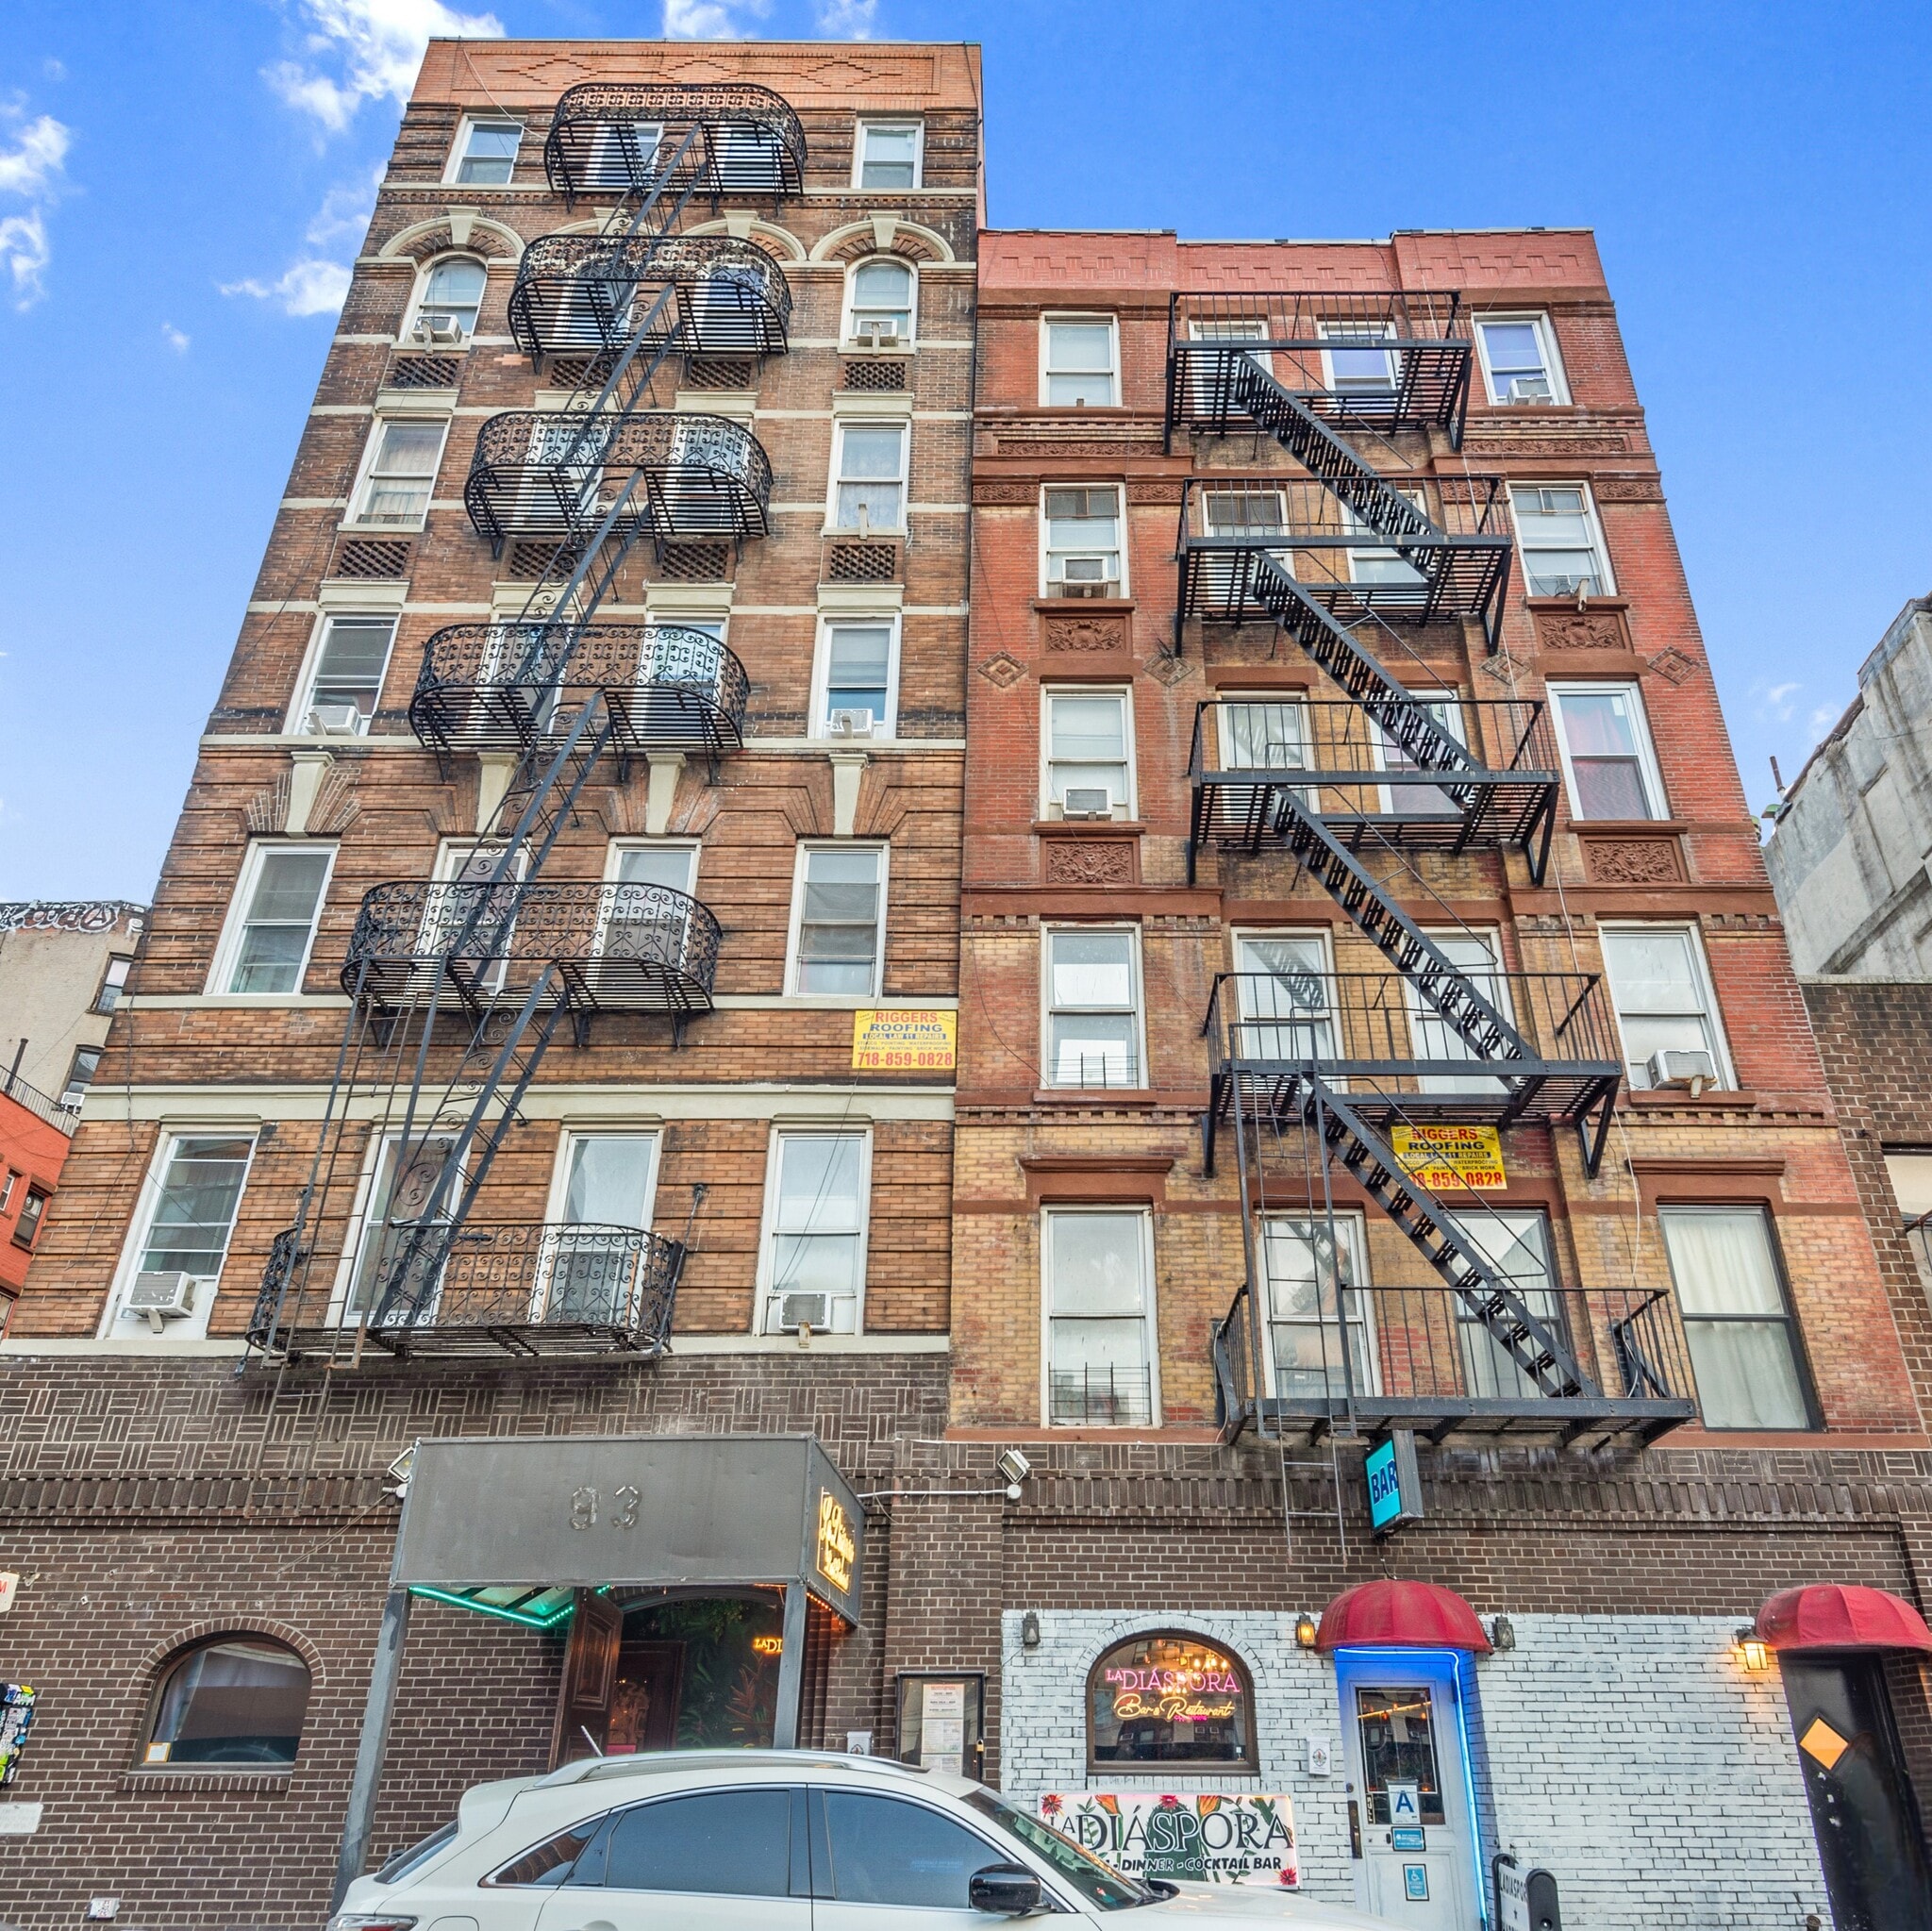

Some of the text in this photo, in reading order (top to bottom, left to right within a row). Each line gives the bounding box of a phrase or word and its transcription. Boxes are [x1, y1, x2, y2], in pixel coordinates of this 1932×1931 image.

[870, 1024, 942, 1032] ROOFING
[875, 1012, 938, 1023] RIGGERS
[858, 1052, 953, 1066] 718-859-0828
[1408, 1141, 1485, 1150] ROOFING
[1371, 1457, 1399, 1506] BAR
[569, 1485, 642, 1531] 93
[1106, 1667, 1241, 1693] LA DIÁSPORA
[1113, 1693, 1154, 1717] Bar
[1159, 1696, 1236, 1720] Restaurant
[1395, 1790, 1415, 1813] A
[1075, 1804, 1294, 1852] DIÁSPORA
[1121, 1858, 1174, 1872] DINNER
[1185, 1857, 1250, 1872] COCKTAIL
[1254, 1856, 1281, 1870] BAR
